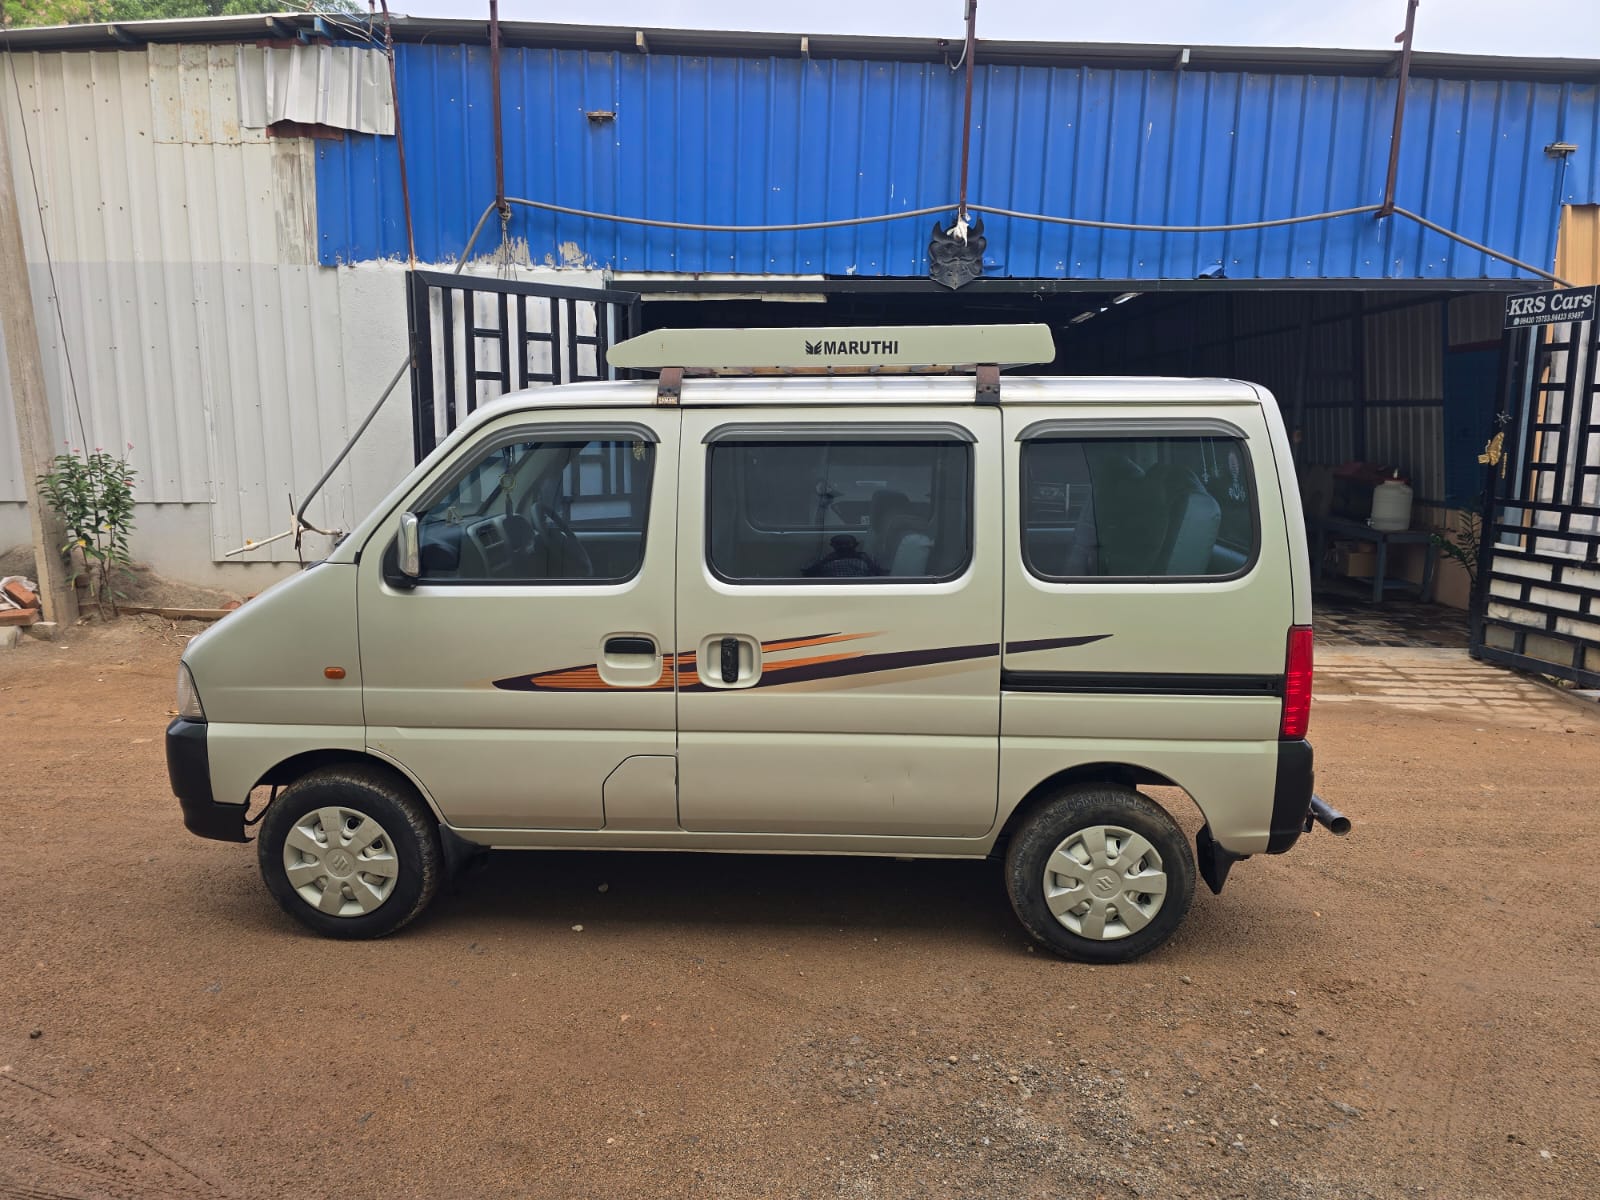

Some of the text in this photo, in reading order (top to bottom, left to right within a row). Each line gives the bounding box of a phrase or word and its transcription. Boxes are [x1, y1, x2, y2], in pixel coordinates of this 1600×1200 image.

[1508, 293, 1593, 316] KRS Cars
[823, 340, 899, 355] MARUTHI
